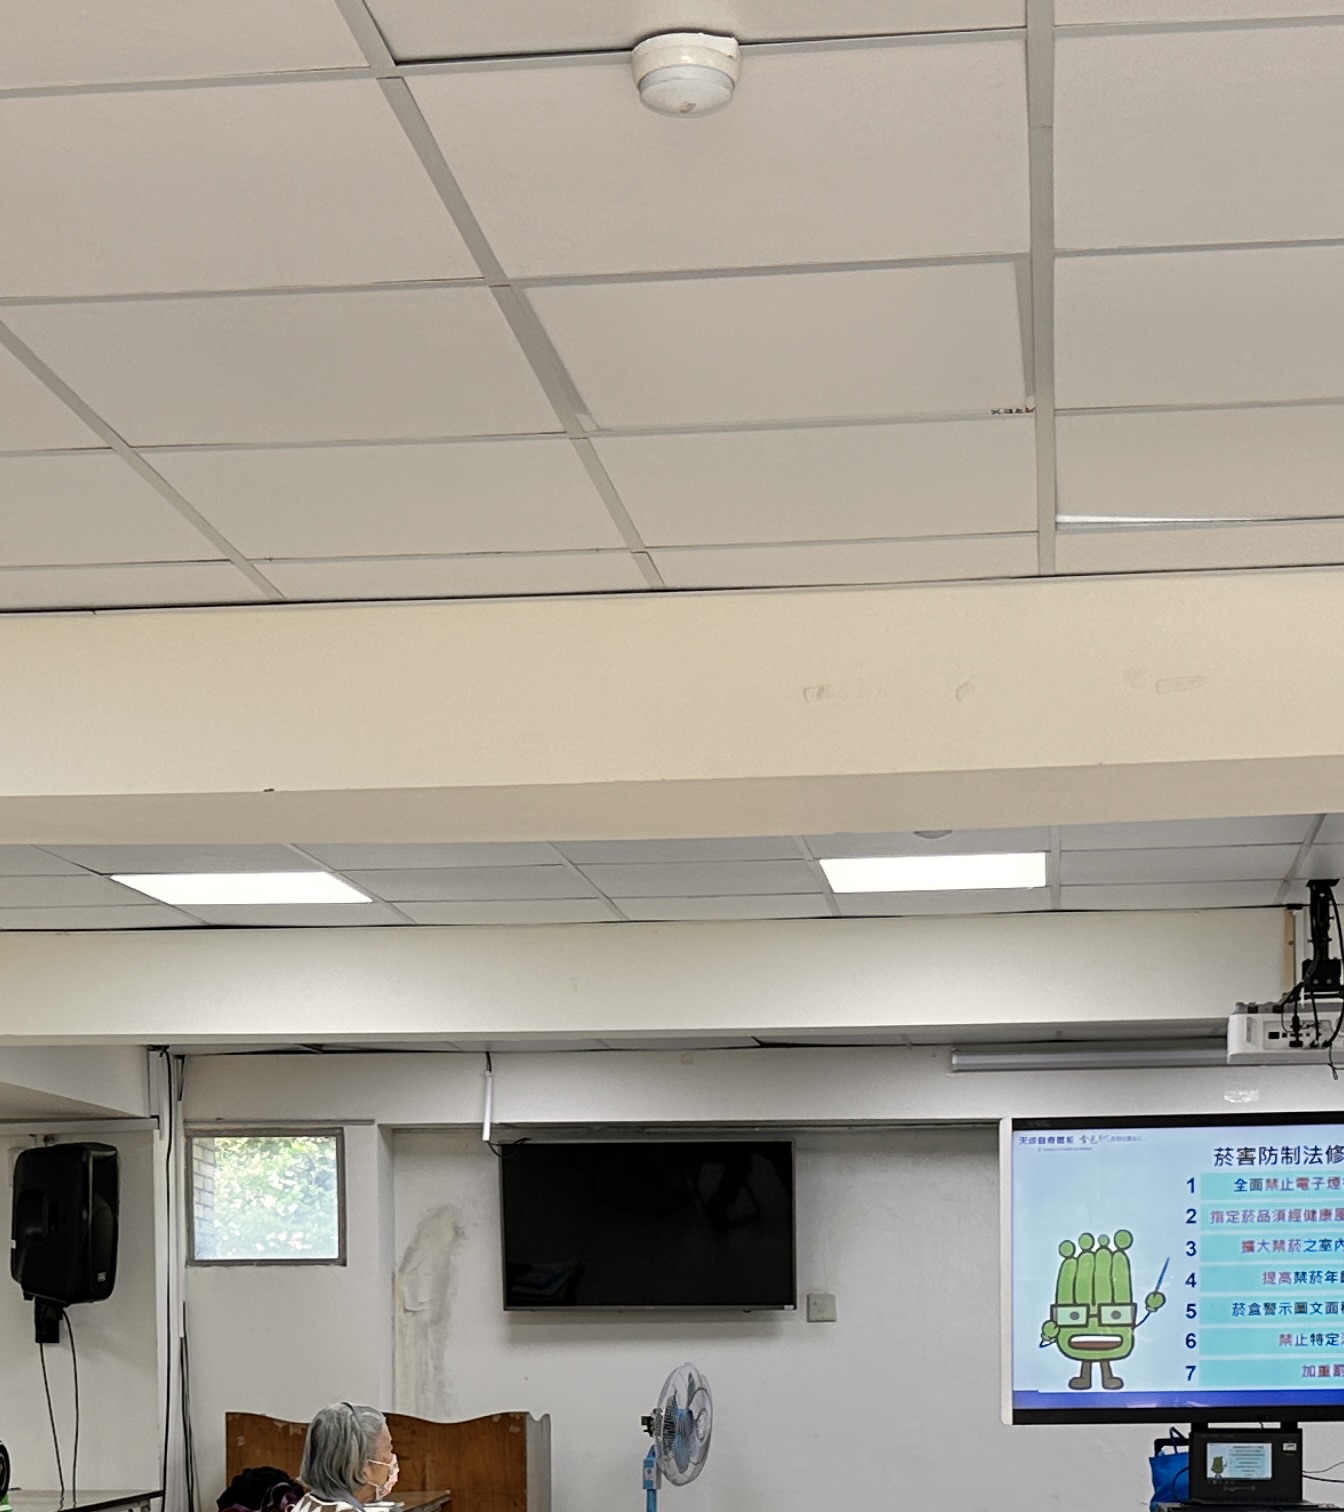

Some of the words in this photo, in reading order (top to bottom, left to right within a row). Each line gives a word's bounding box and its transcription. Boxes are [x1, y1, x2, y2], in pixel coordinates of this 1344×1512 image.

[1186, 1178, 1196, 1193] 1
[1185, 1209, 1197, 1224] 2
[1185, 1241, 1197, 1257] 3
[1185, 1273, 1197, 1288] 4
[1185, 1304, 1197, 1319] 5
[1185, 1334, 1197, 1349] 6
[1185, 1366, 1196, 1381] 7
